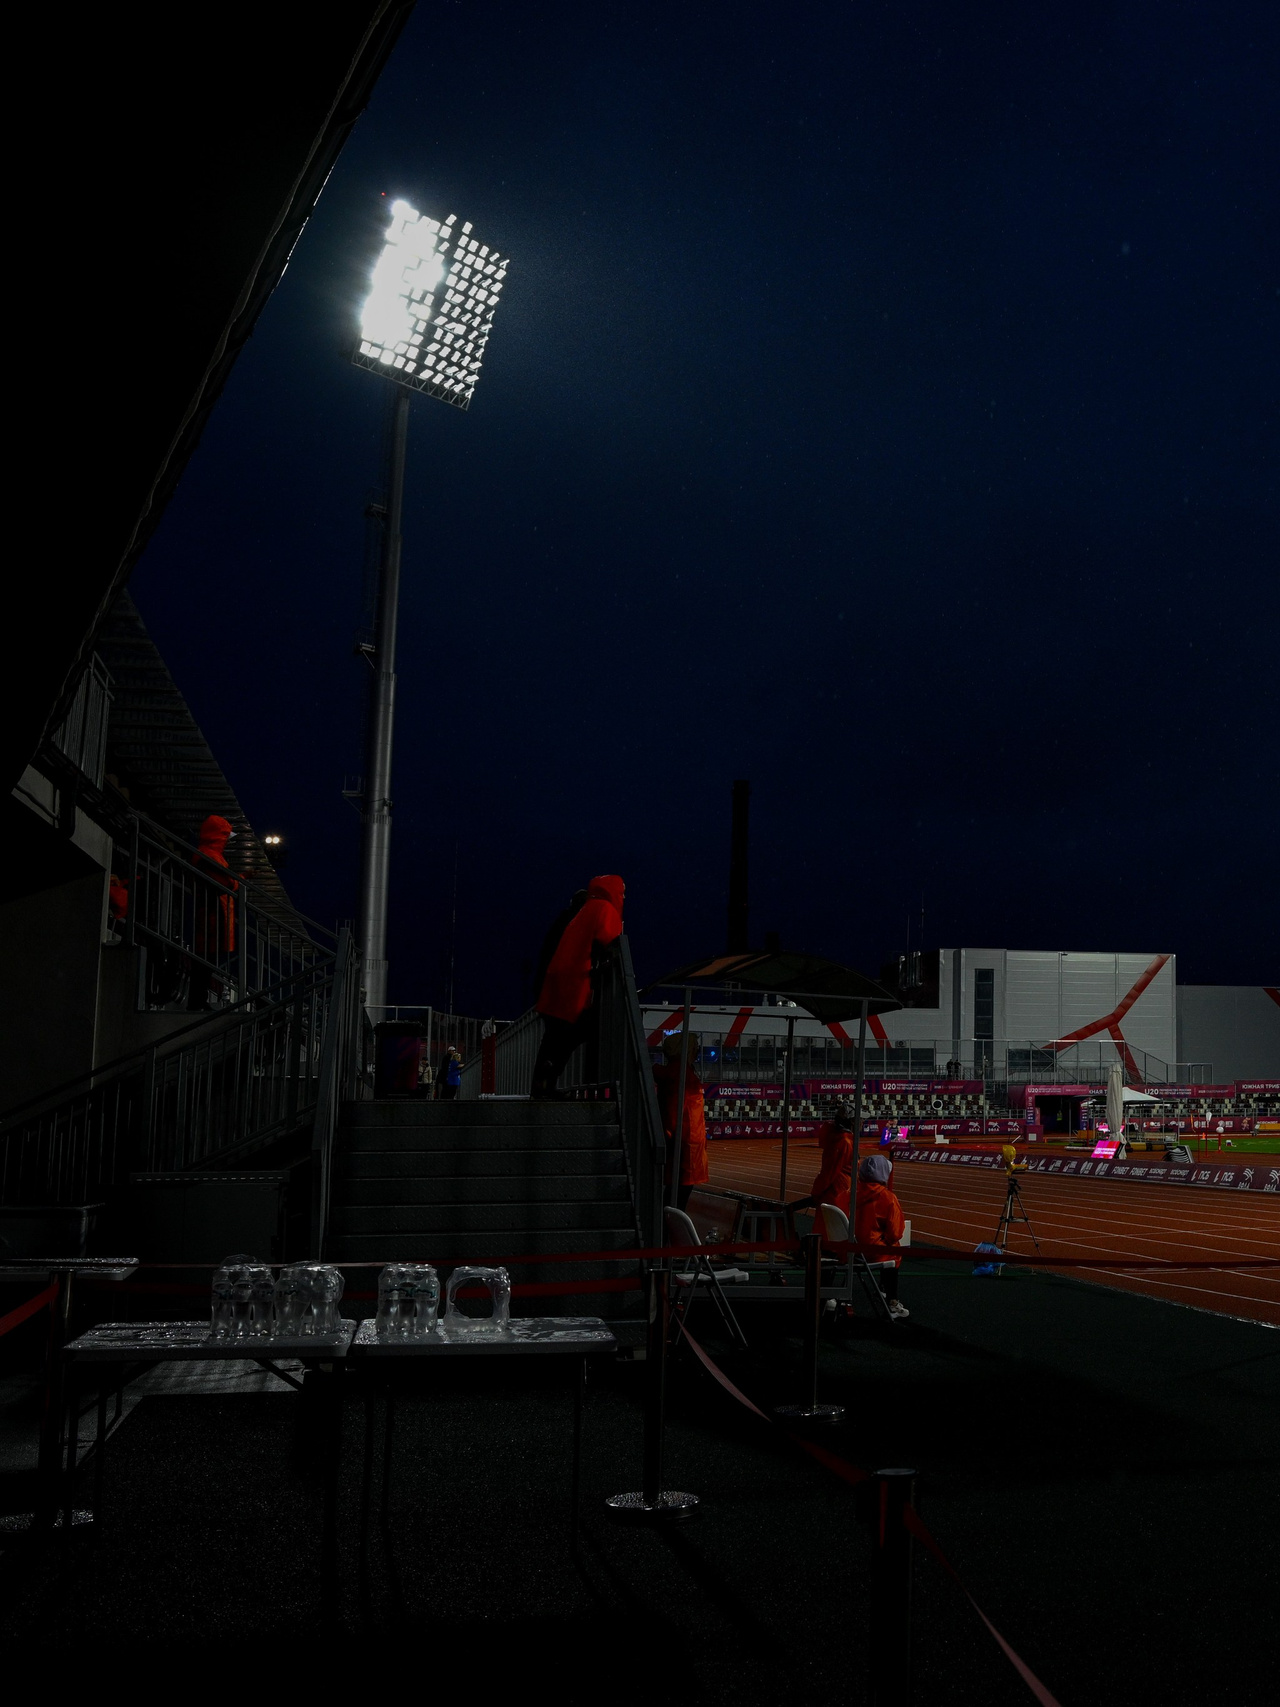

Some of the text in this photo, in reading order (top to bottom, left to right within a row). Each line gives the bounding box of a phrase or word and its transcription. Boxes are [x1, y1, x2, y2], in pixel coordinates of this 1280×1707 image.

[719, 1088, 733, 1096] U20
[1198, 1170, 1211, 1180] ПСБ
[1221, 1172, 1235, 1182] ПСБ
